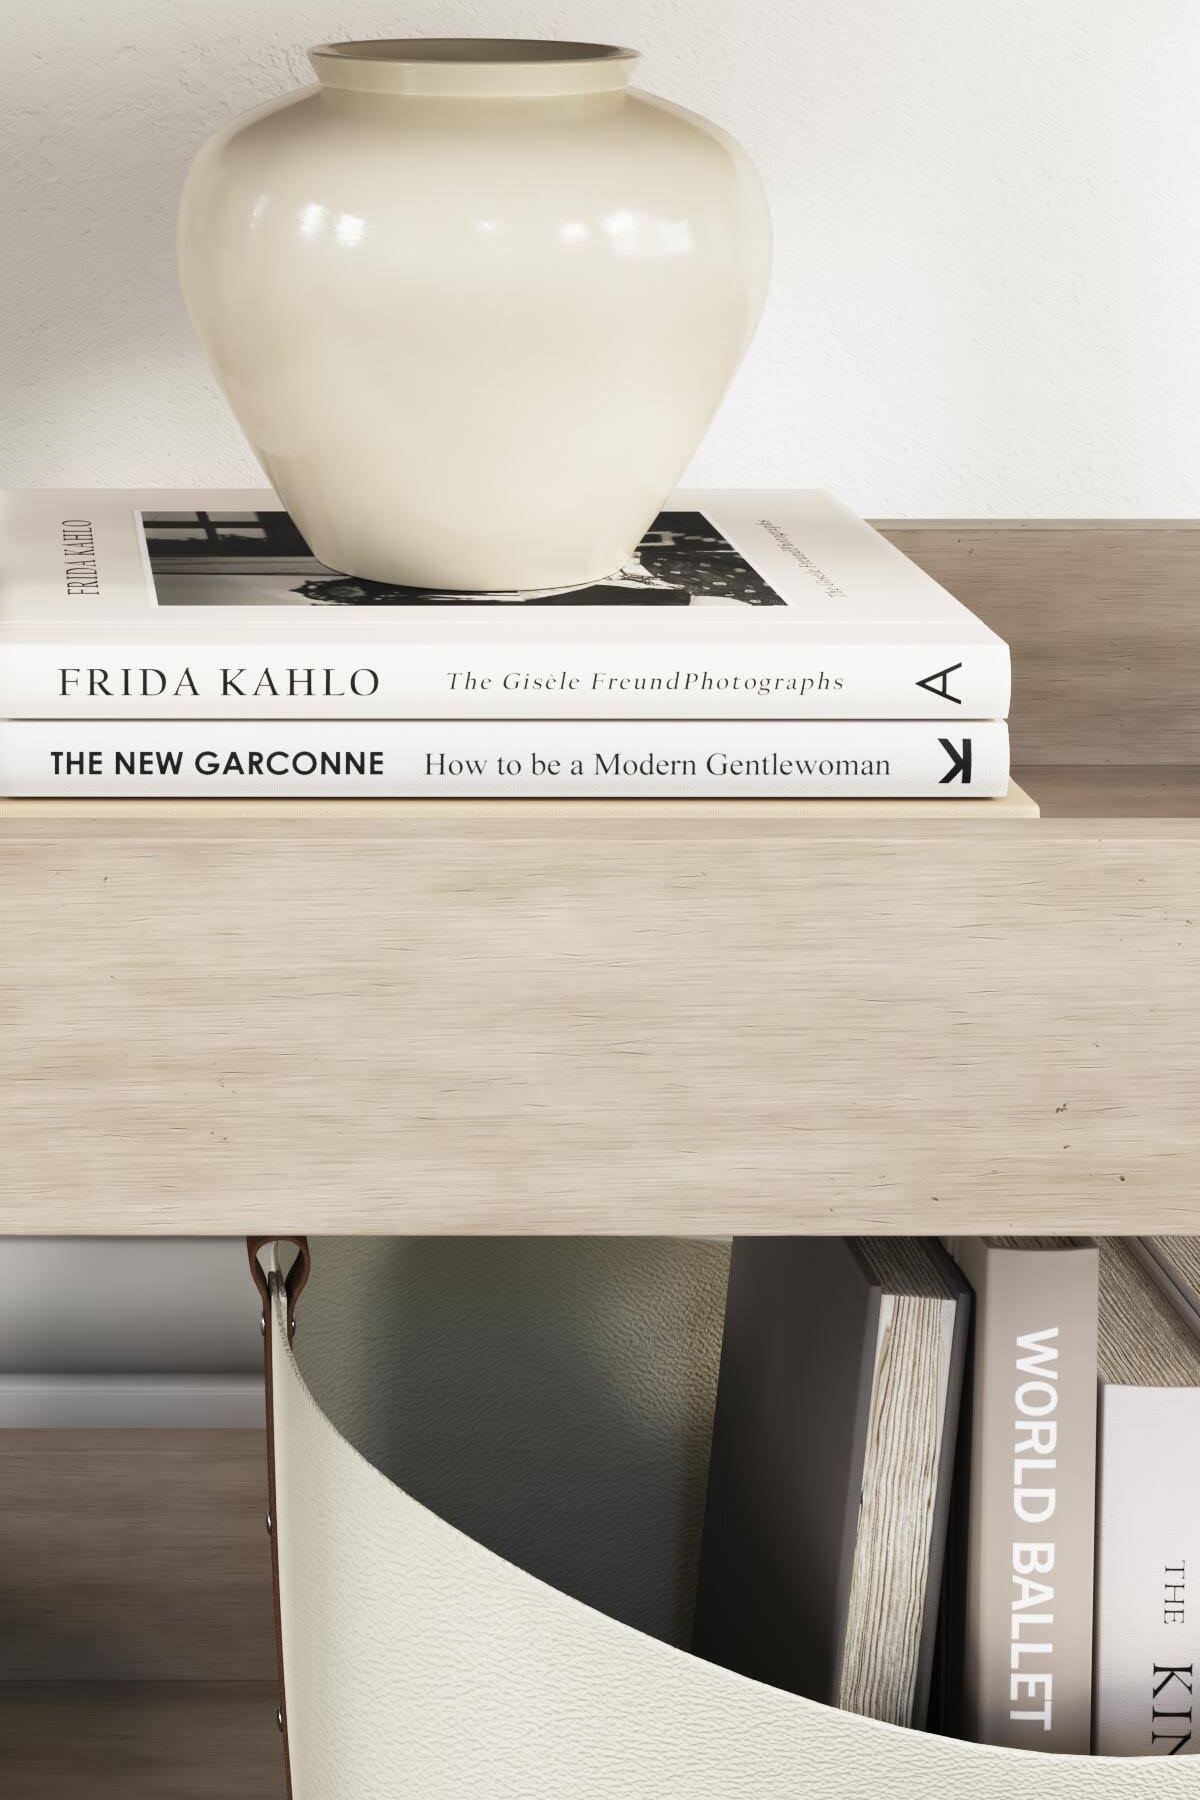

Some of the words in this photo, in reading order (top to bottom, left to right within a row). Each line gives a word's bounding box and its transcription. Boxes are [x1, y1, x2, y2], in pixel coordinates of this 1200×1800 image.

[61, 519, 95, 556] KAHLO
[63, 559, 100, 596] FRIDA
[57, 667, 201, 697] FRIDA
[219, 667, 380, 697] KAHLO
[447, 671, 492, 691] The
[502, 671, 580, 691] Gisèle
[50, 751, 103, 776] THE
[115, 751, 184, 776] NEW
[194, 750, 384, 777] GARCONNE
[425, 752, 488, 777] How
[496, 756, 522, 777] to
[530, 751, 561, 777] be
[570, 758, 584, 777] a
[593, 751, 697, 777] Modern
[706, 751, 892, 777] Gentlewoman
[1013, 1326, 1060, 1524] WORLD
[1163, 1559, 1186, 1625] THE
[1009, 1541, 1056, 1731] BALLET
